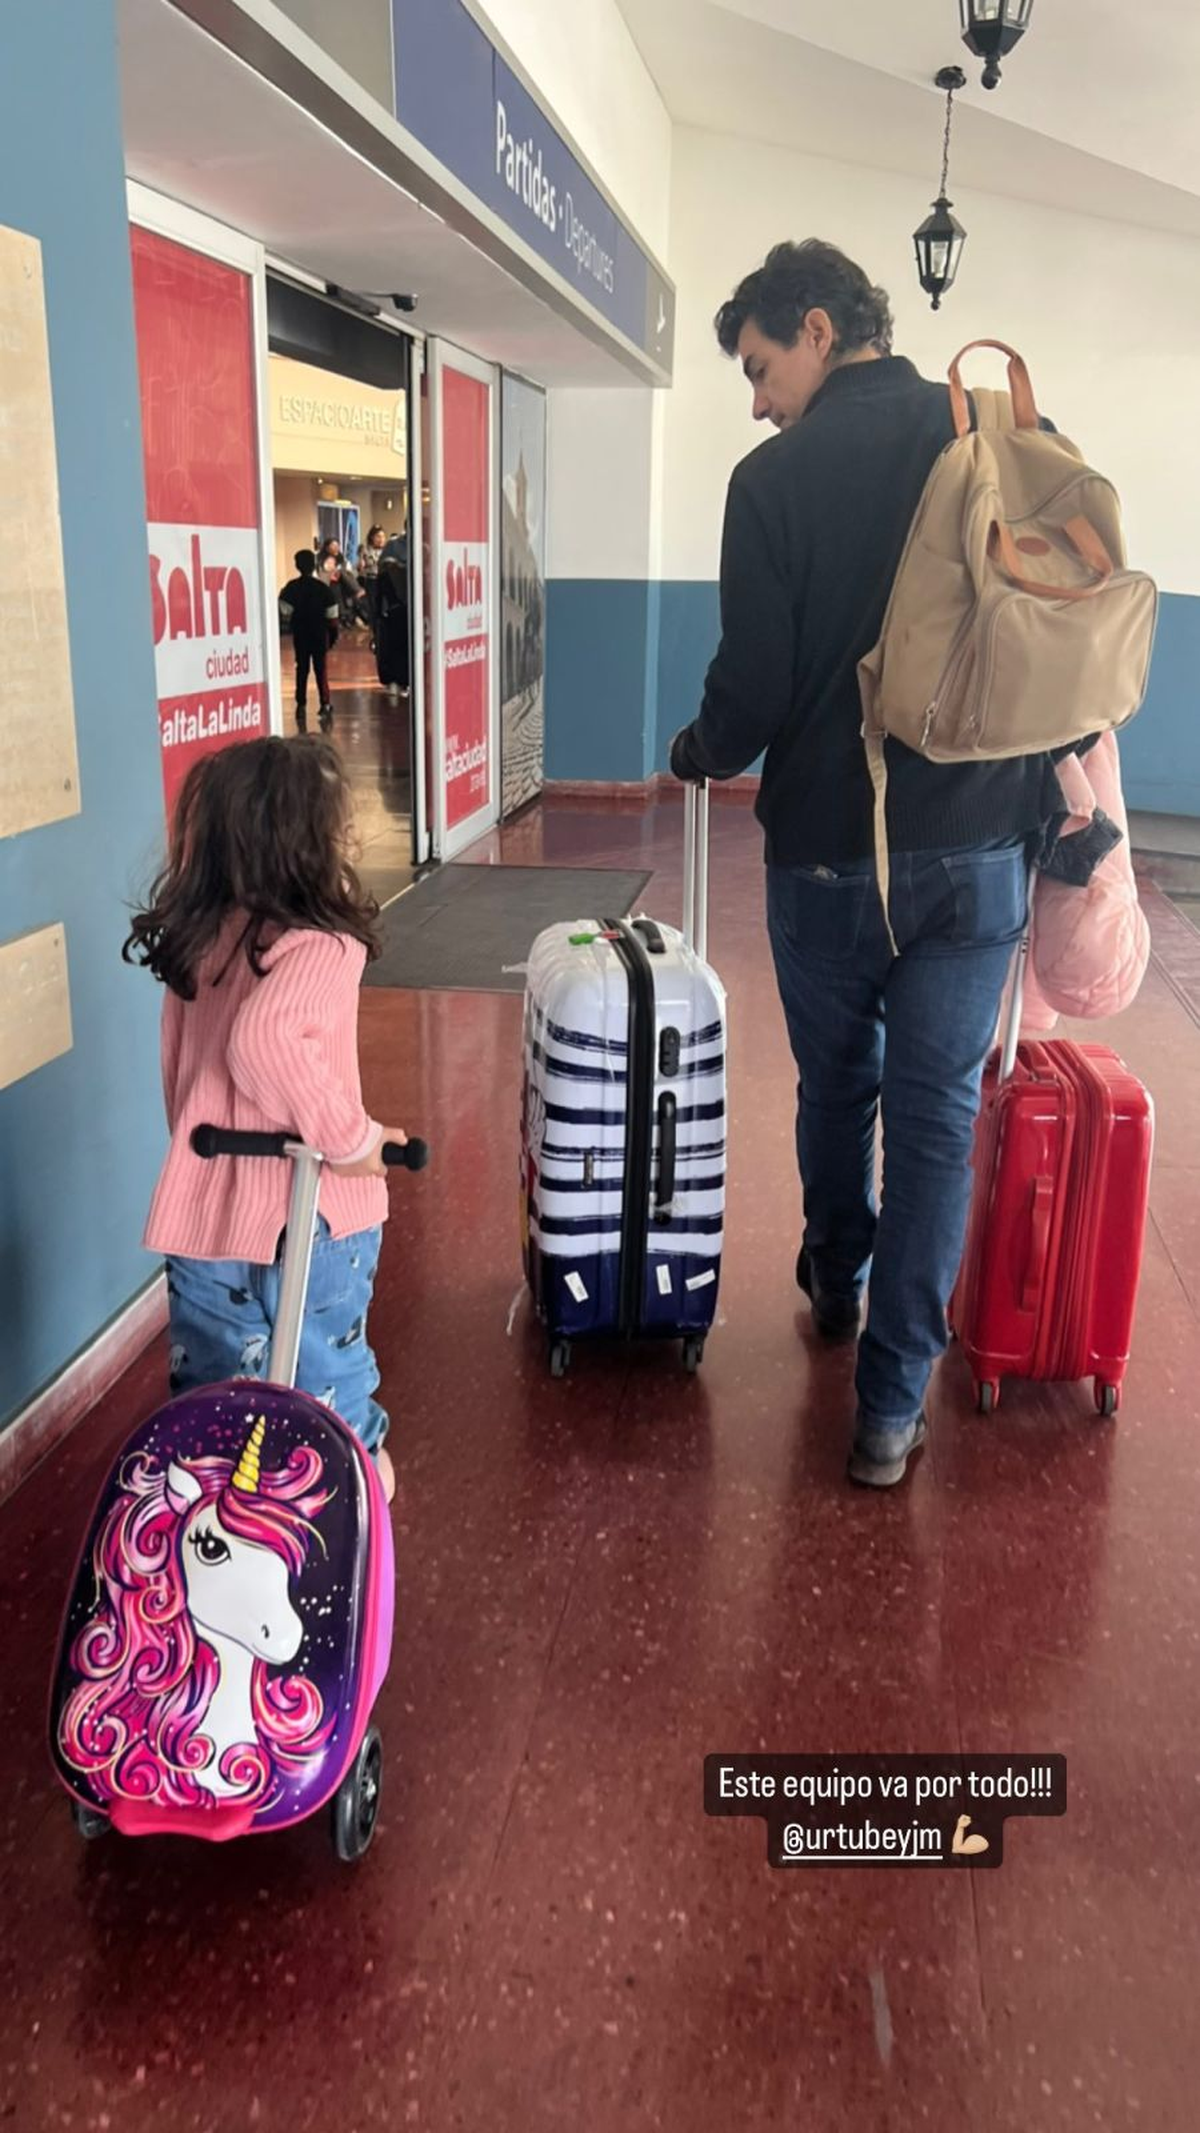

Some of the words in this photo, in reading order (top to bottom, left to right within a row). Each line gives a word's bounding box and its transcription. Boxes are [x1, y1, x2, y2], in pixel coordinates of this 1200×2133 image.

[495, 100, 556, 231] Partidas
[565, 192, 614, 293] Departures
[206, 647, 249, 679] ciudad
[159, 696, 261, 747] altaLaLinda
